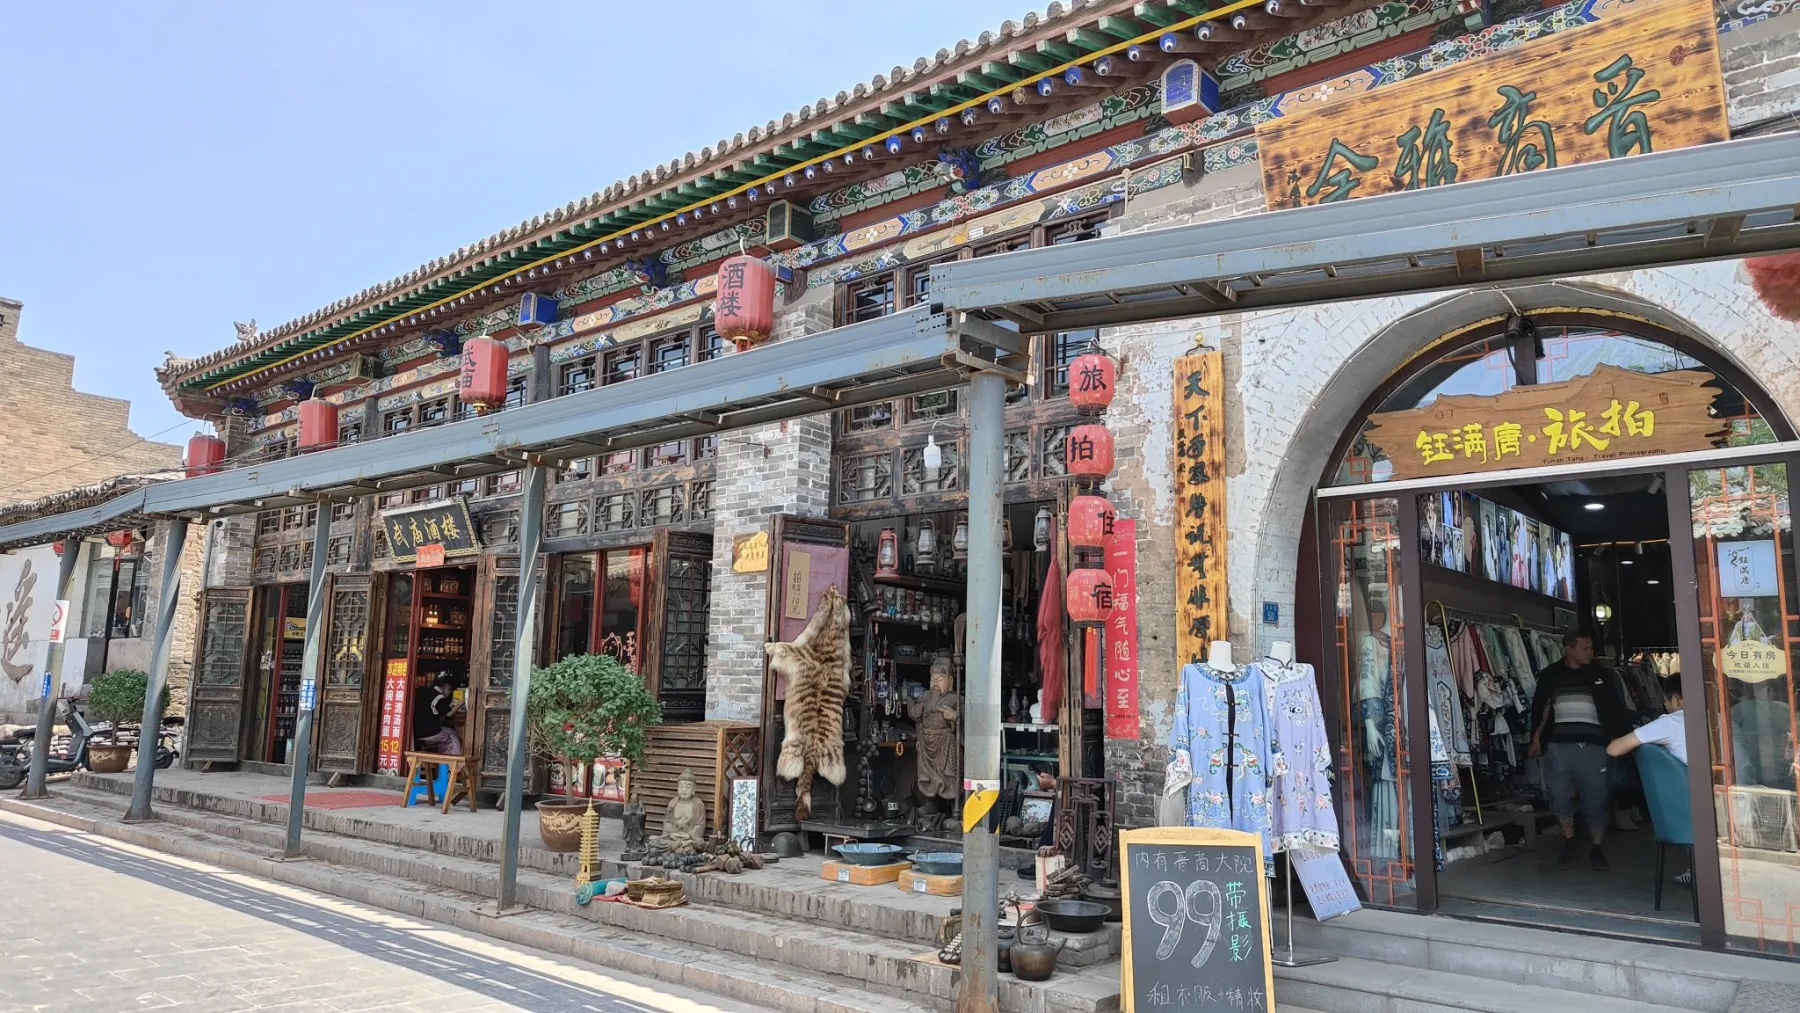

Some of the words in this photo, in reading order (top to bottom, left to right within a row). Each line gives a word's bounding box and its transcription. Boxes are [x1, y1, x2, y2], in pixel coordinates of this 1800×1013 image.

[718, 262, 748, 318] 酒楼
[461, 346, 477, 389] 武庙
[392, 512, 461, 549] 武庙酒楼
[1112, 551, 1131, 709] 一门福气随心至
[1267, 611, 1275, 621] 50
[1726, 650, 1776, 660] 今日有房
[1734, 661, 1770, 669] 欢迎入住
[1147, 879, 1222, 969] 99
[1225, 881, 1252, 962] 带摄影
